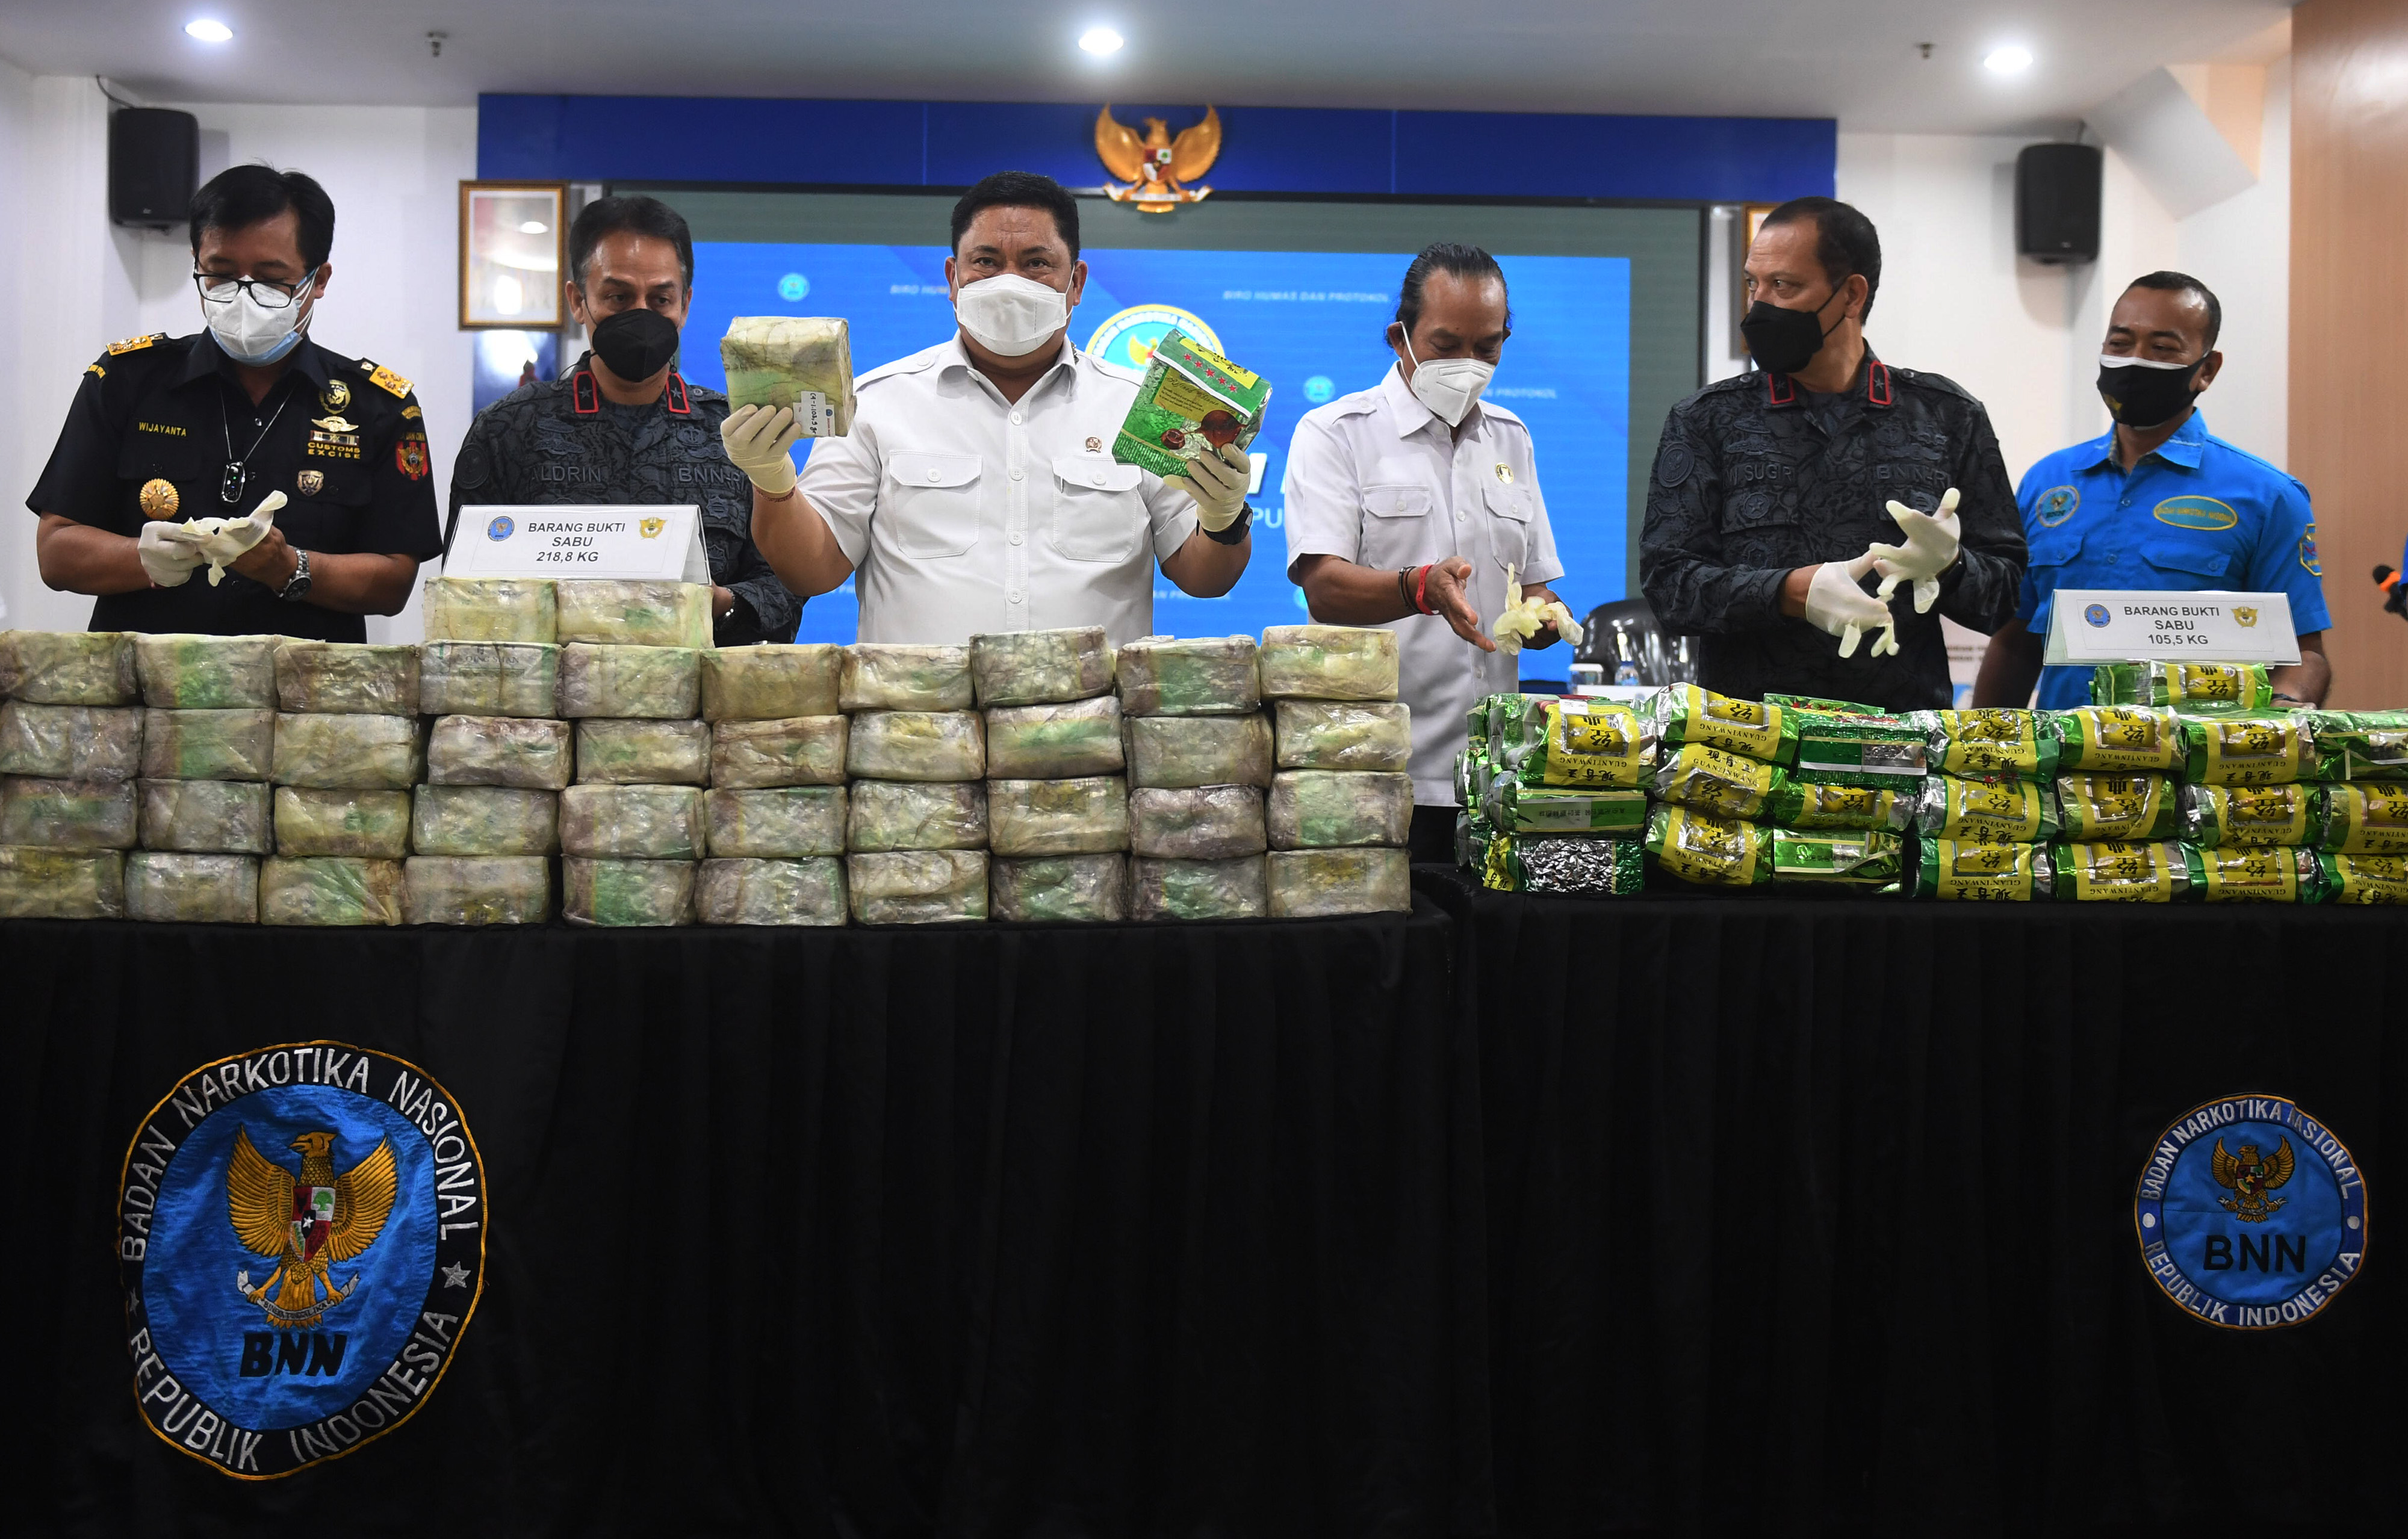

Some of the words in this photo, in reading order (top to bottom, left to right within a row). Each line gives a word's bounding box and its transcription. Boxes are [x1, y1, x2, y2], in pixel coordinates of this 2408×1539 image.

[138, 422, 187, 437] WIJAYANTA
[308, 442, 361, 457] CUSTOMS
[308, 448, 361, 459] EXCISE
[531, 466, 601, 482] ALDRIN
[528, 522, 582, 534] BARANG
[588, 522, 625, 533] BUKTI
[552, 537, 592, 547] SABU
[536, 551, 572, 563] 218,8
[577, 551, 598, 562] KG
[2124, 606, 2177, 616] BARANG
[2182, 606, 2220, 616] BUKTI
[2155, 621, 2194, 630] SABU
[2147, 635, 2182, 646] 105,5
[2186, 634, 2208, 645] KG
[1699, 723, 1767, 742] GUANYINWANG
[1560, 757, 1627, 767] GUANYINWANG
[2094, 753, 2160, 763] GUANYINWANG
[2219, 761, 2286, 770] GUANYINWANG
[1958, 818, 2027, 832] GUANYINWANG
[2090, 886, 2159, 894] GUANYINWANG
[122, 1125, 176, 1262] BADAN
[172, 1048, 370, 1129] NARKOTIKA
[388, 1071, 479, 1241] NASIONAL
[2141, 1141, 2180, 1201] BADAN
[2171, 1099, 2282, 1145] NARKOTIKA
[2203, 1234, 2306, 1273] BNN
[2144, 1240, 2229, 1324] REPUBLIK
[2239, 1252, 2360, 1327] INDONESIA
[241, 1333, 347, 1378] BNN
[129, 1327, 264, 1472] REPUBLIK
[289, 1311, 459, 1463] INDONESIA
